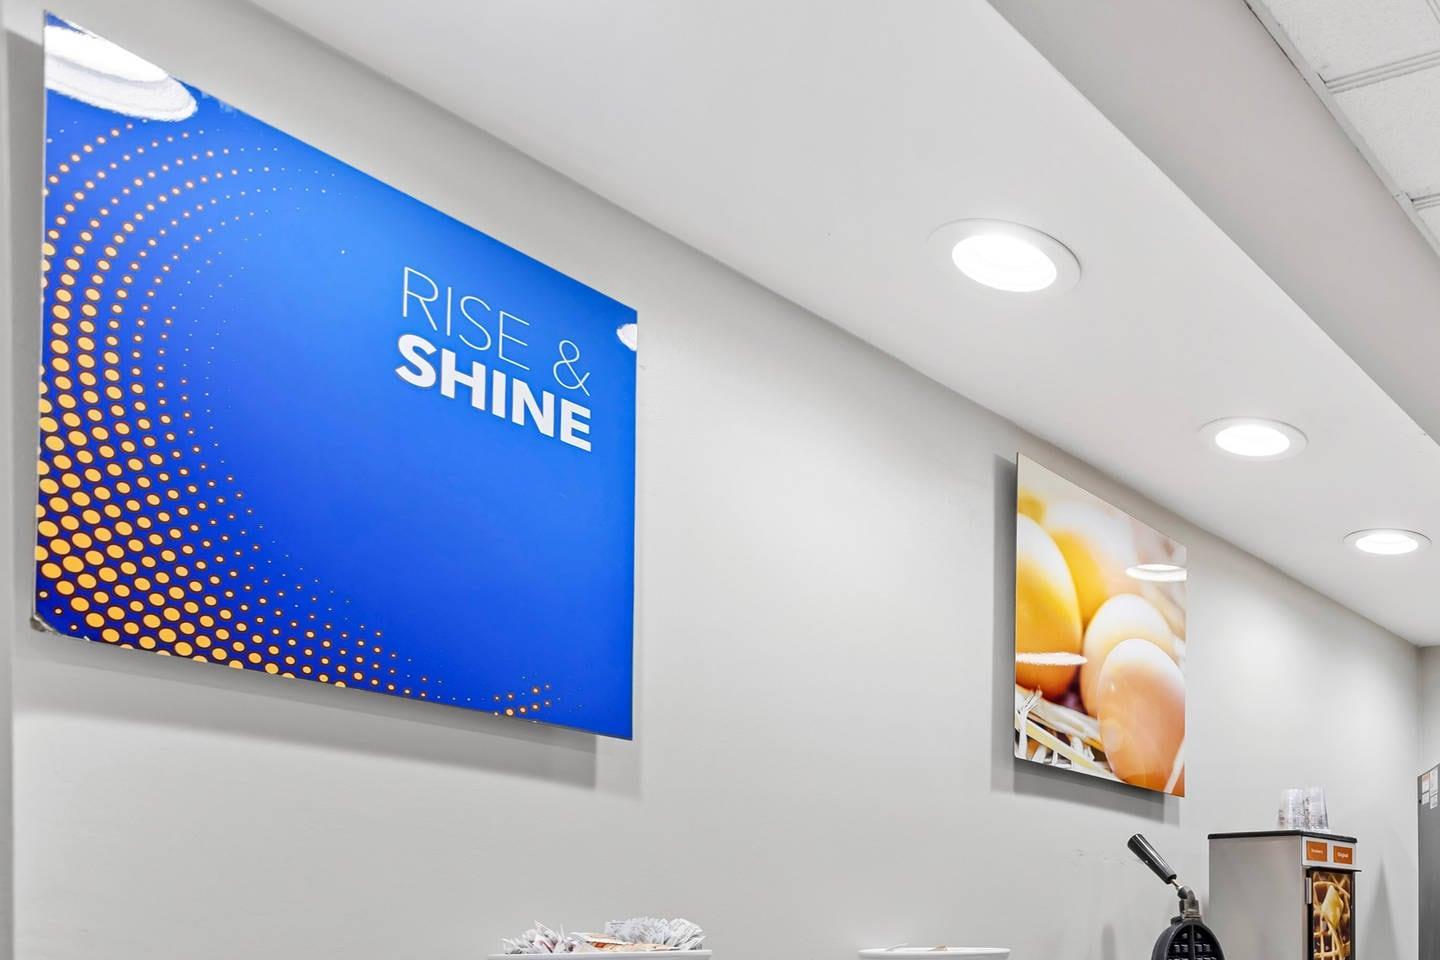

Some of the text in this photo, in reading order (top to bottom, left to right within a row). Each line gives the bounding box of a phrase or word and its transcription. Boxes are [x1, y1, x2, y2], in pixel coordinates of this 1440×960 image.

[394, 333, 592, 452] SHINE
[402, 266, 591, 397] RISE &
